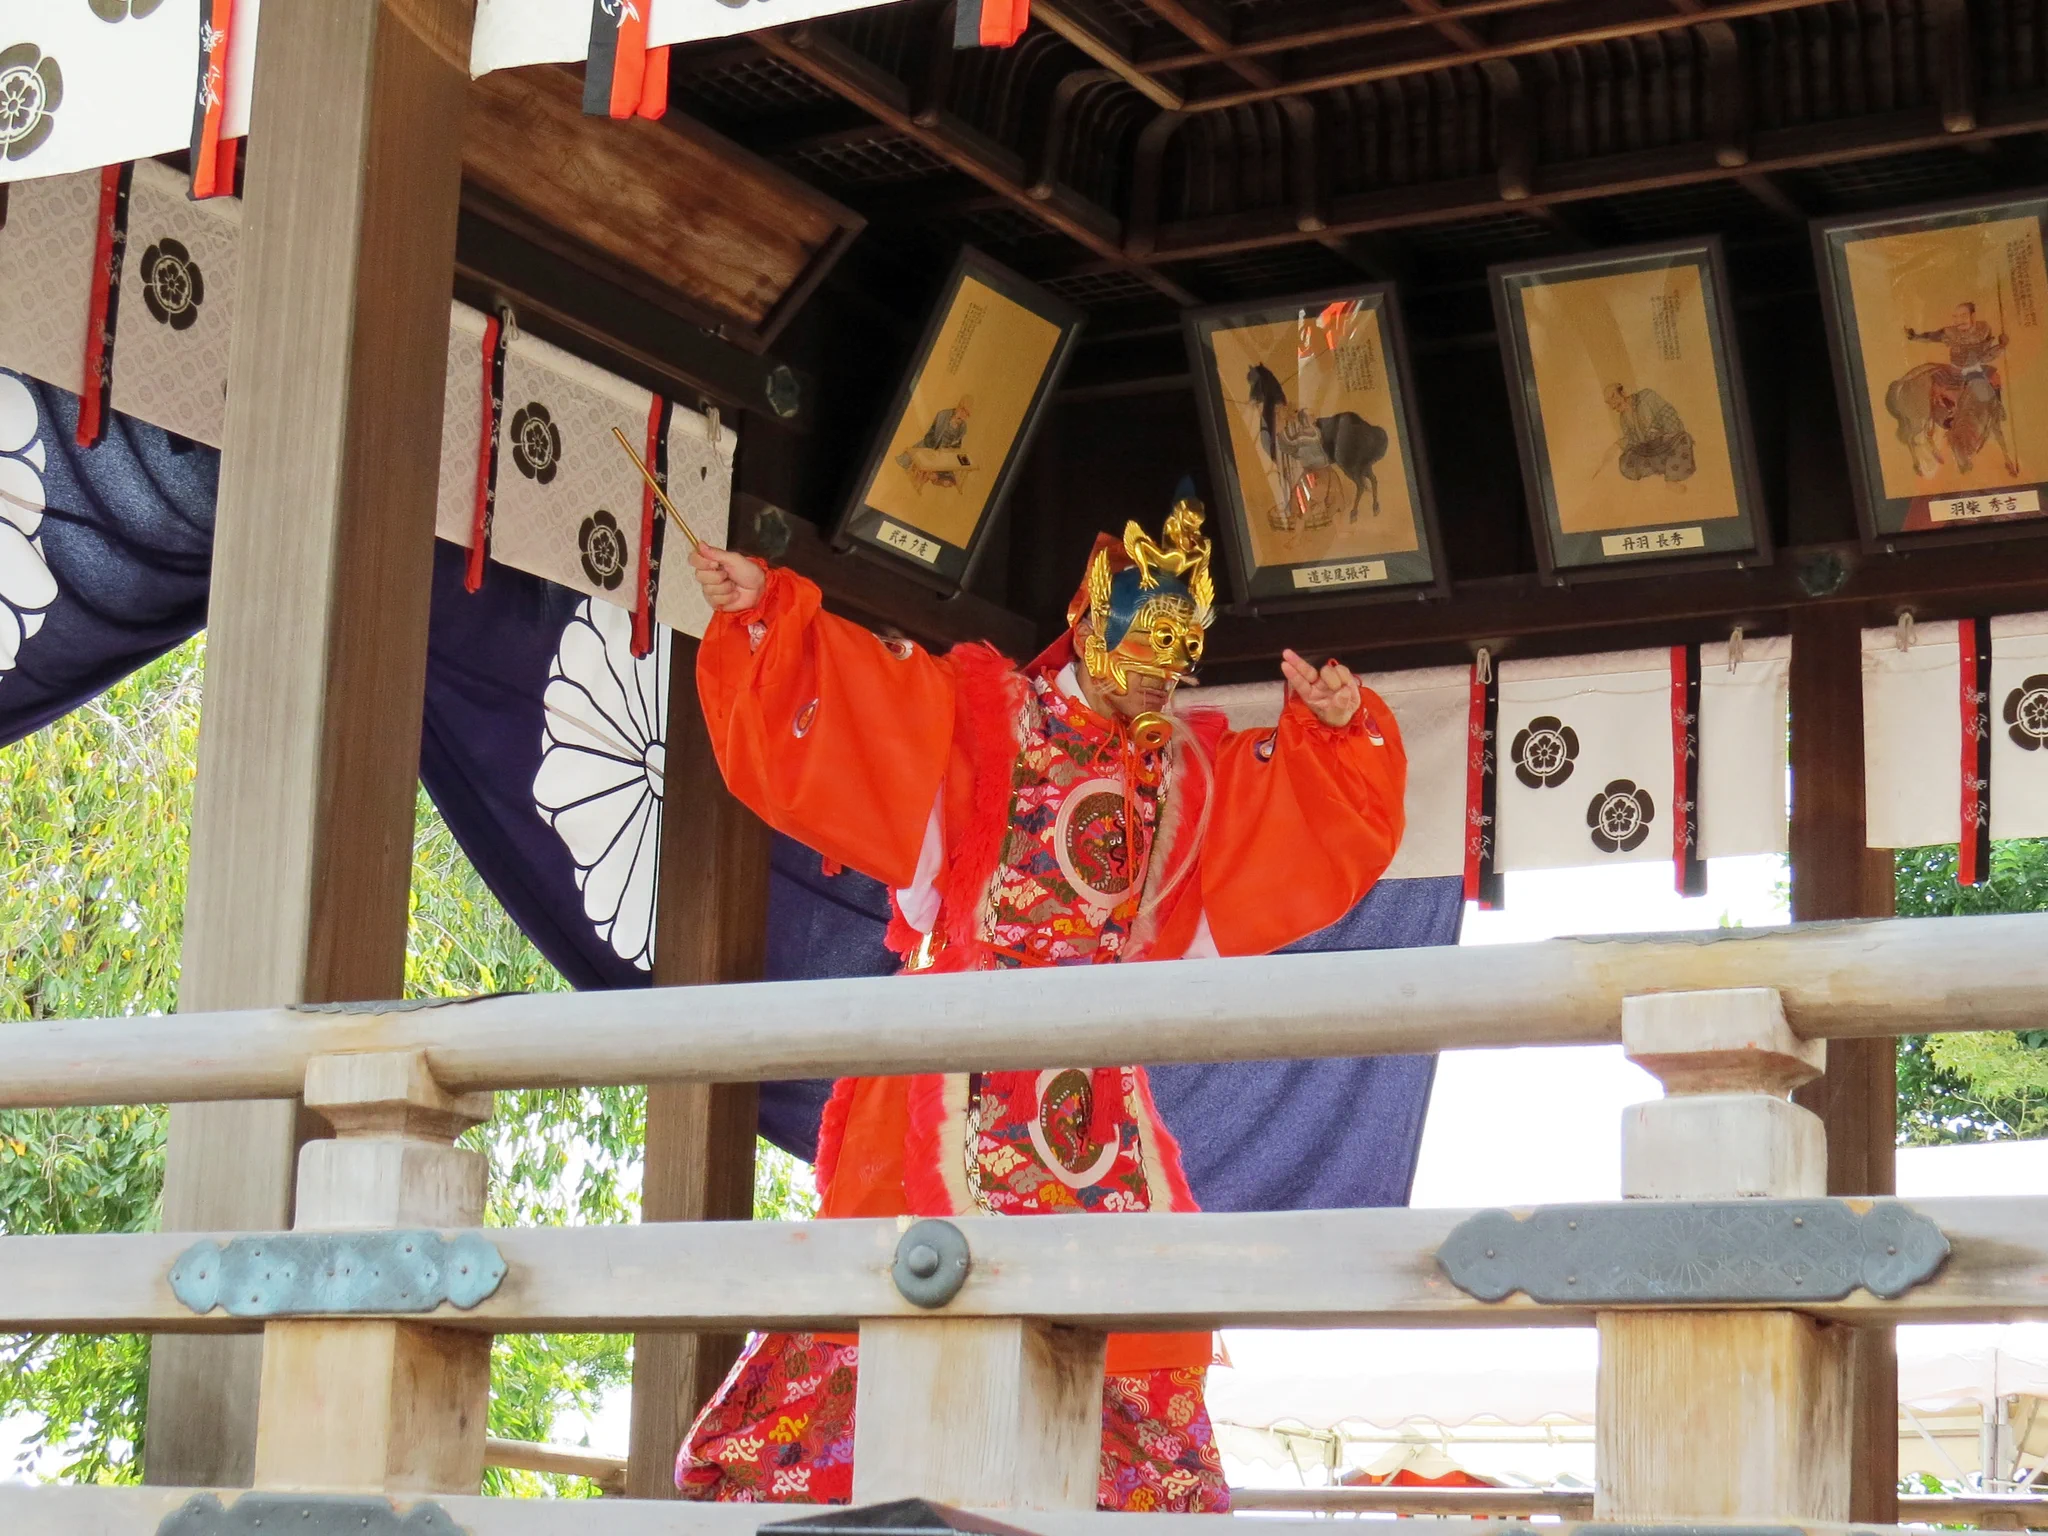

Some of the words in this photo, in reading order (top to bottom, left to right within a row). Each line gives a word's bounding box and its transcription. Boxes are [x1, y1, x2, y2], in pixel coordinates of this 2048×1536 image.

[1951, 501, 1981, 516] 羽柴
[1988, 496, 2017, 512] 秀吉
[1622, 535, 1650, 551] 丹羽
[1656, 531, 1684, 548] 長秀
[1307, 565, 1371, 584] 道家尾張守
